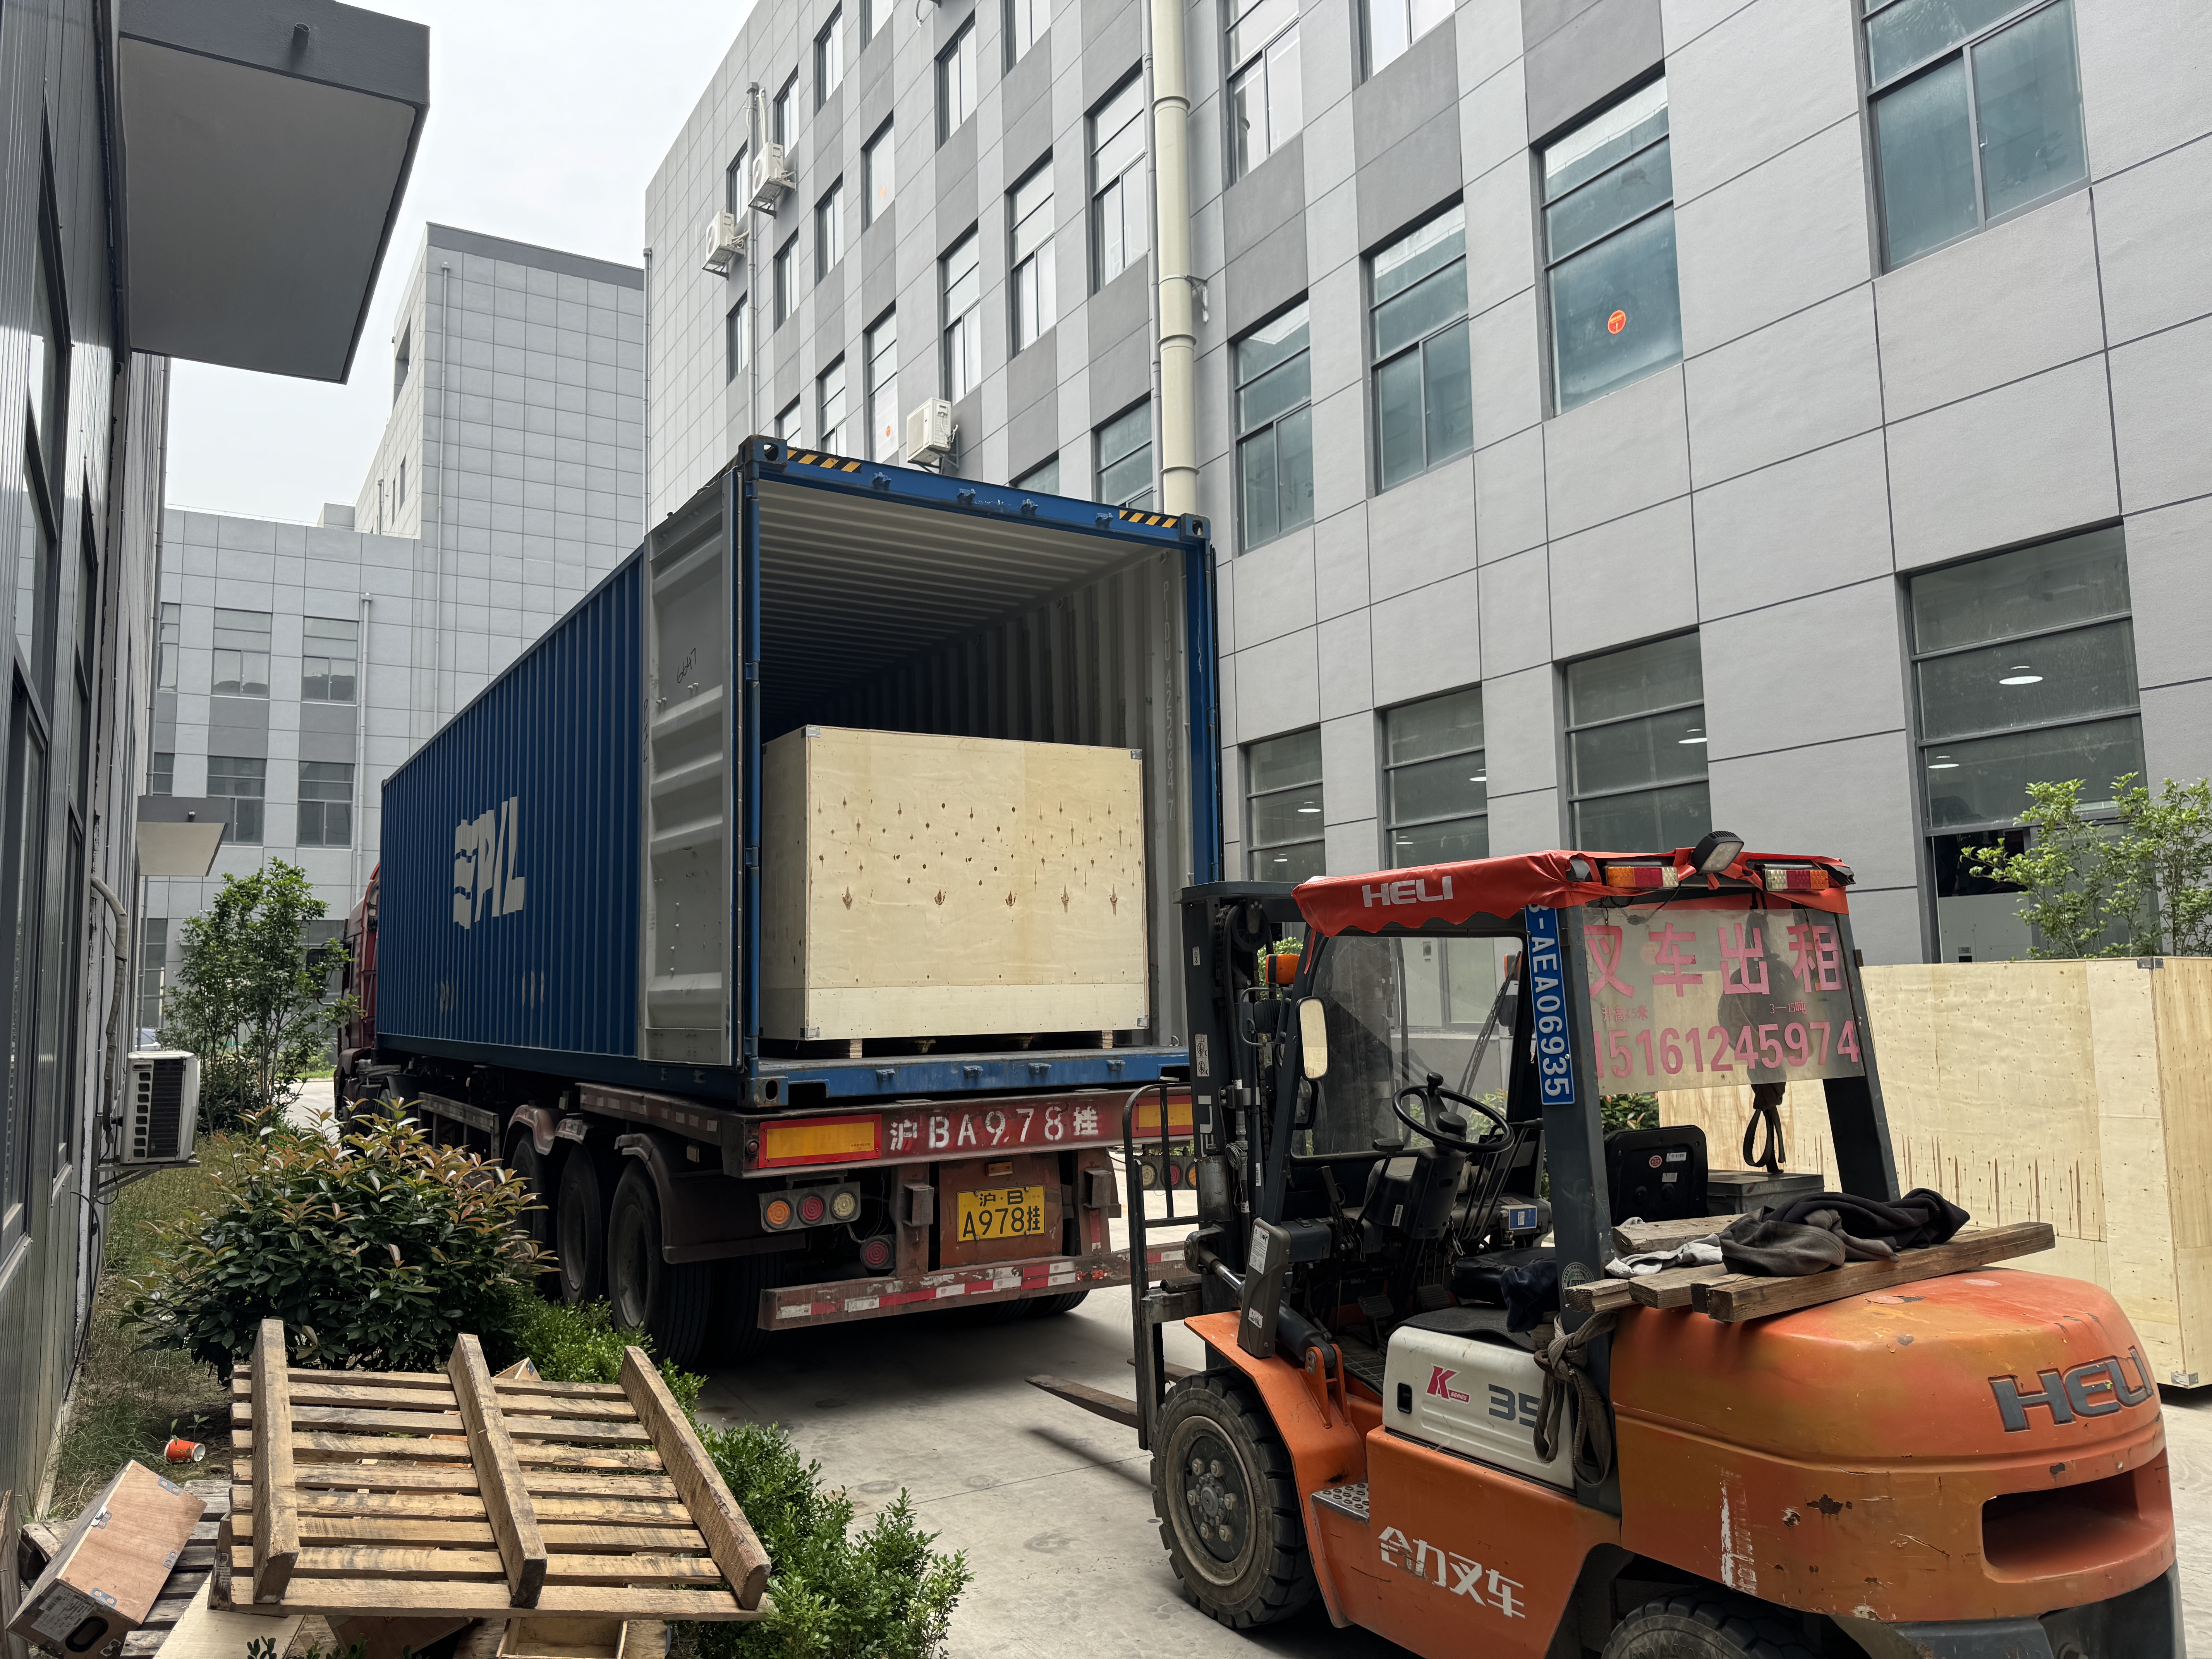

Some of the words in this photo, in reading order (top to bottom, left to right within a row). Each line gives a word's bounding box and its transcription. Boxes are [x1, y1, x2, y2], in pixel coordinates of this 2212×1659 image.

[677, 647, 696, 683] 6647
[1166, 669, 1174, 790] 425664
[1168, 800, 1173, 819] 7
[1362, 875, 1453, 907] HELI
[1583, 922, 1842, 998] 叉车出租
[1593, 1020, 1859, 1079] 15161245974
[890, 1106, 1099, 1151] 沪BA978挂
[963, 1205, 1041, 1238] A978挂
[1426, 1364, 1460, 1401] K
[1450, 1391, 1467, 1400] SERIES
[1987, 1345, 2154, 1434] HELI
[1488, 1383, 1541, 1428] 35
[1378, 1526, 1526, 1619] 合力叉车
